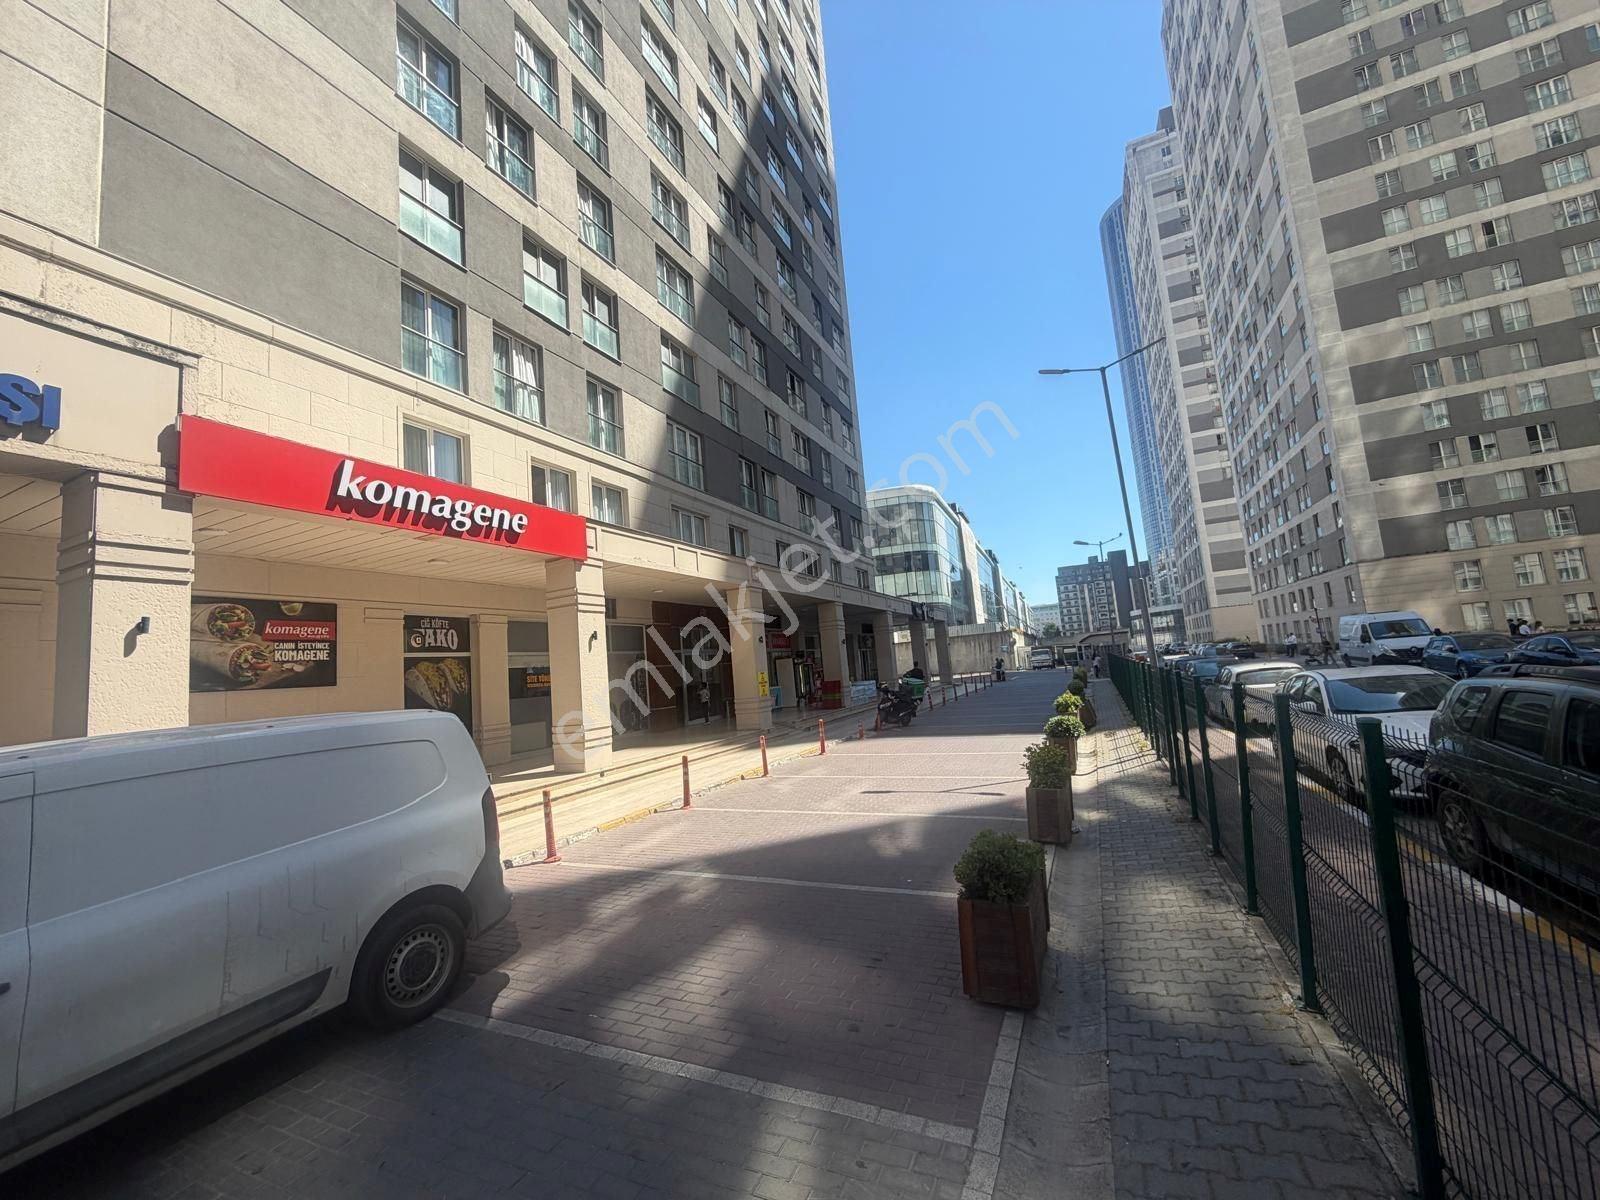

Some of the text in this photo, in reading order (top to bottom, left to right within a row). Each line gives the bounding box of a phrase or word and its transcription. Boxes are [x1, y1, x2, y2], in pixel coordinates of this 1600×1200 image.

[337, 459, 528, 533] komagene
[265, 622, 329, 638] komagene
[274, 642, 295, 650] CANIN
[274, 650, 330, 661] KOMAGENE
